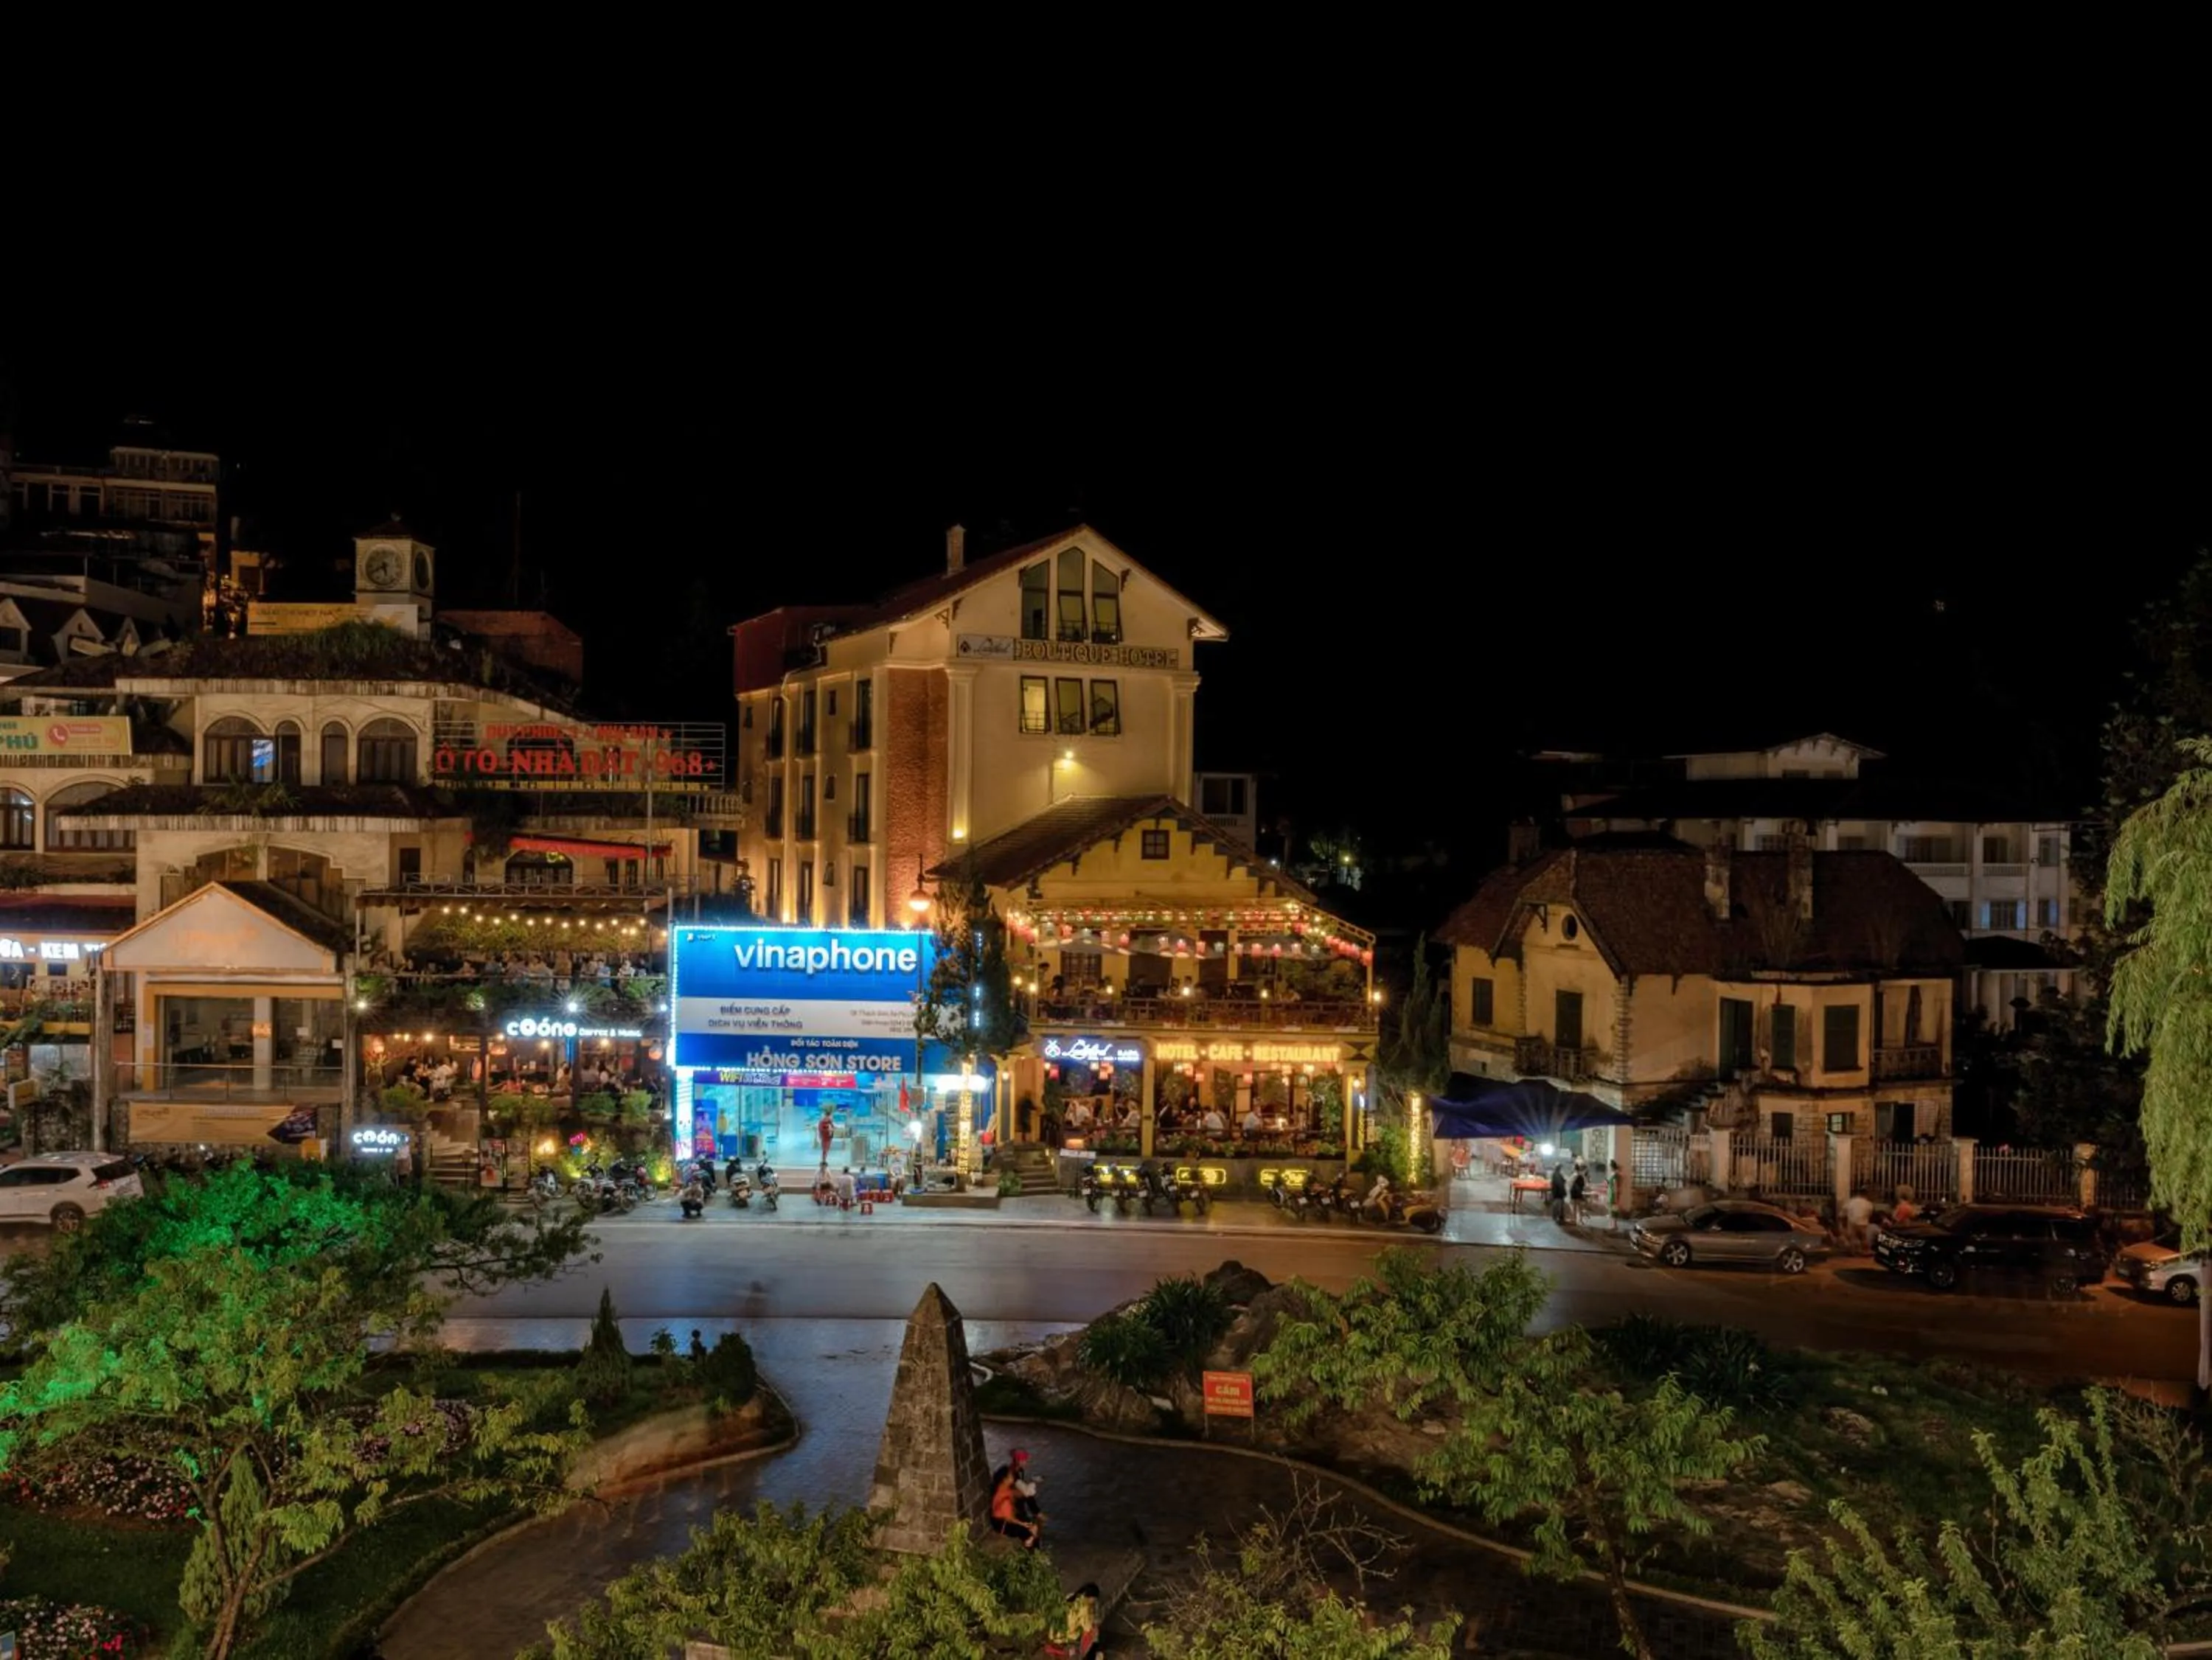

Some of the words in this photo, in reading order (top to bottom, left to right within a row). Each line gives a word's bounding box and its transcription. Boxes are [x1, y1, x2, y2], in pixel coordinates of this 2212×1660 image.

[1022, 641, 1110, 664] BOUTIQUE
[1119, 646, 1172, 669] HOTEL
[511, 741, 576, 775] NHÀ
[41, 942, 79, 959] KEM
[734, 938, 917, 974] vinaphone
[744, 1005, 770, 1015] CUNG
[771, 1019, 803, 1029] THÔNG
[1156, 1044, 1199, 1060] HOTEL
[1208, 1045, 1244, 1061] CAFE
[1253, 1046, 1341, 1062] RESTAURANT
[805, 1053, 843, 1070] SƠN
[846, 1054, 902, 1072] STORE
